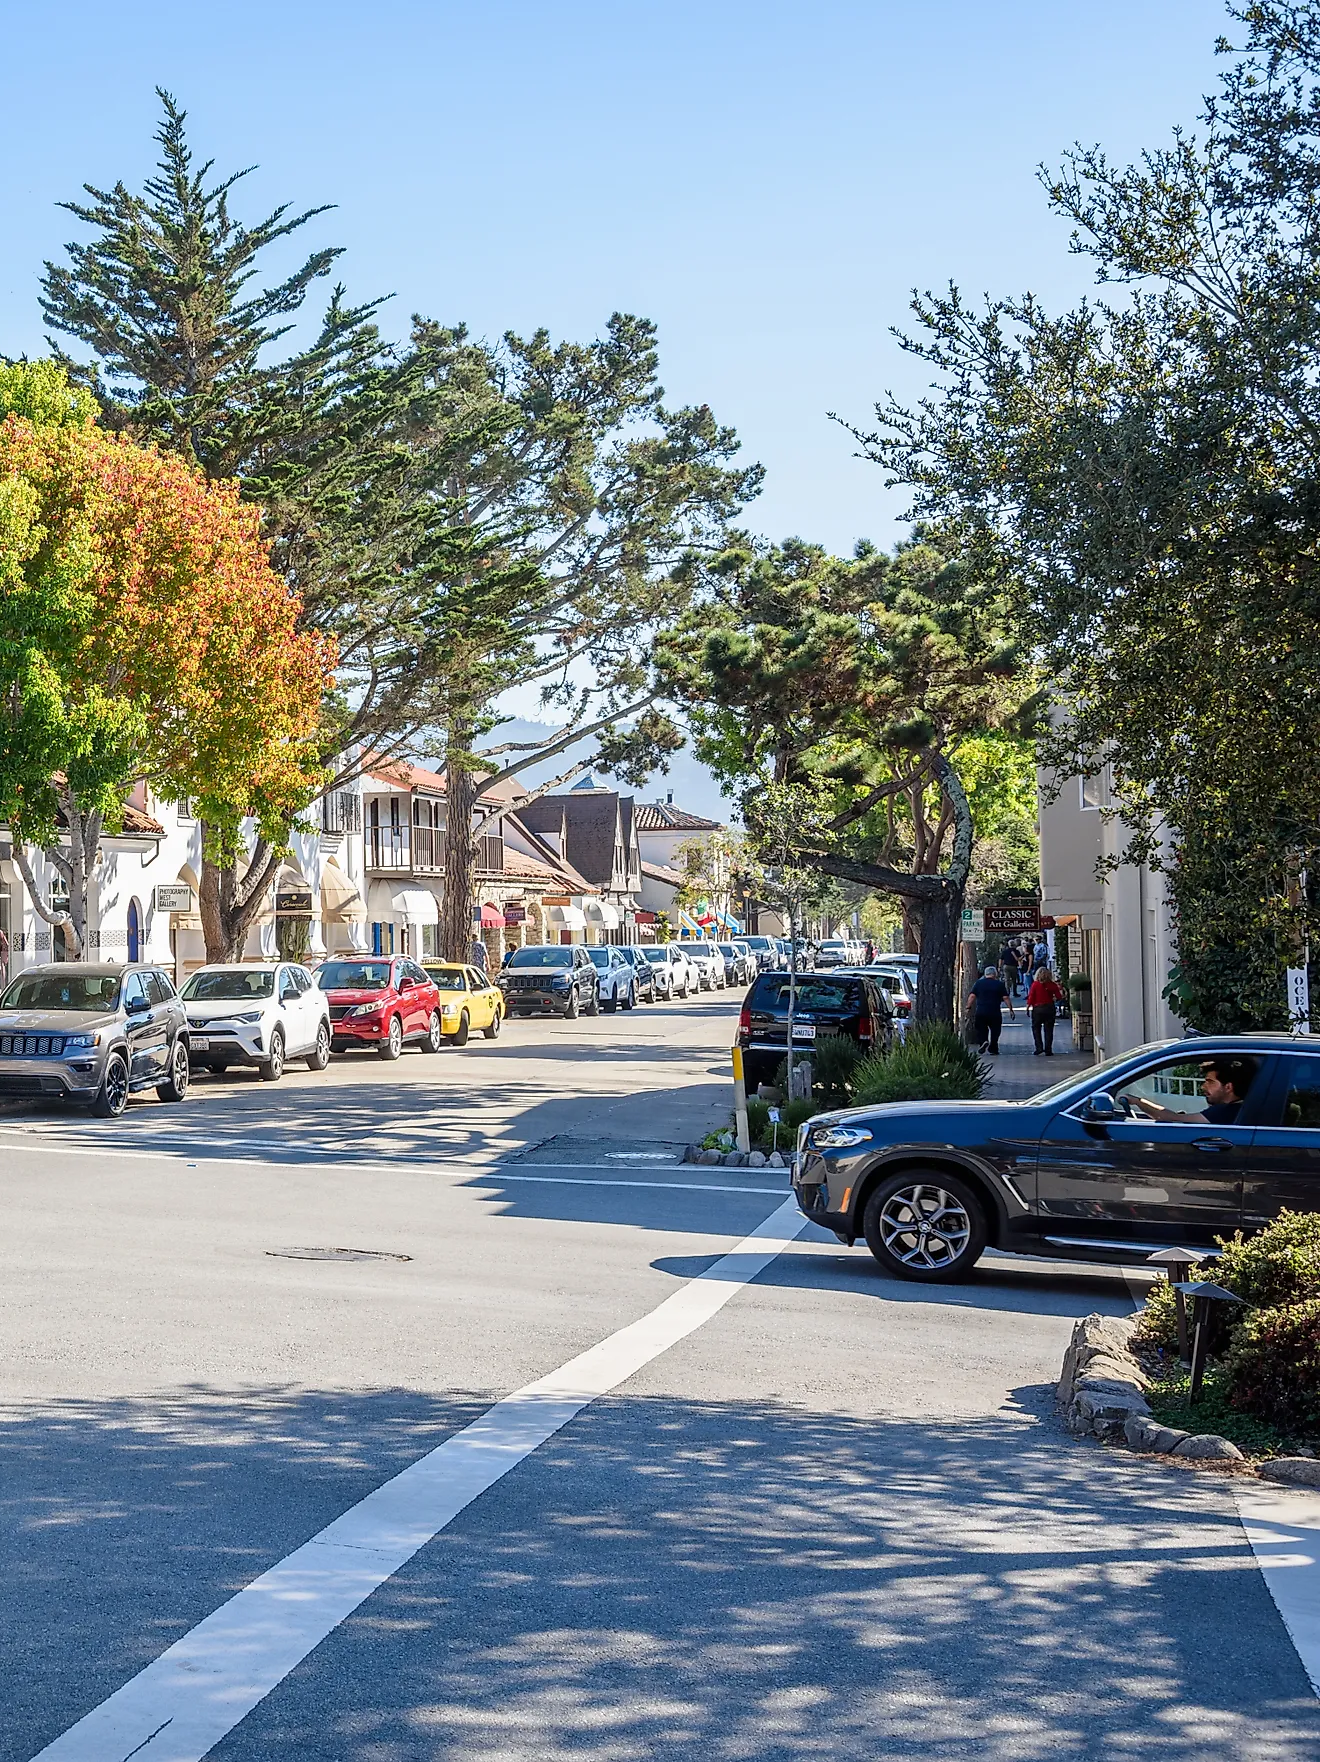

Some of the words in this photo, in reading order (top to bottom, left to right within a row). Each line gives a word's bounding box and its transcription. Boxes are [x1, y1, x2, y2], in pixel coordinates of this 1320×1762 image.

[964, 911, 971, 919] 2
[991, 910, 1032, 919] CLASSIC
[989, 920, 1002, 928] Art
[1003, 920, 1035, 928] Galleries
[795, 1012, 810, 1020] Jeep
